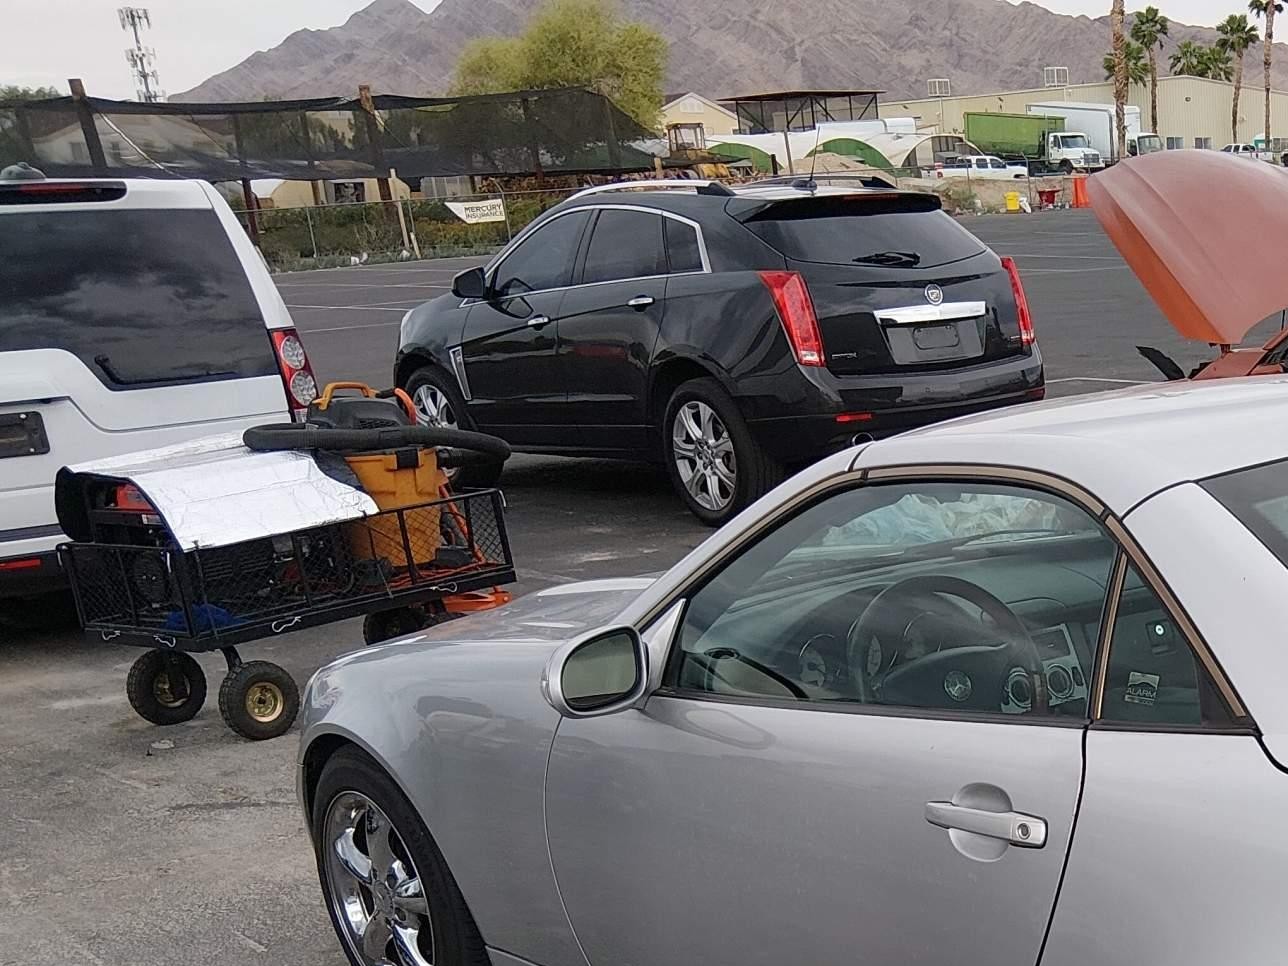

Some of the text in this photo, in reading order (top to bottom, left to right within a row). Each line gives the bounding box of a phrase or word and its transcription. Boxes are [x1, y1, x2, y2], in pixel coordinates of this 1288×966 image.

[464, 203, 502, 214] MERCURY
[465, 211, 504, 219] INSURANCE
[1126, 687, 1157, 699] ALARM
